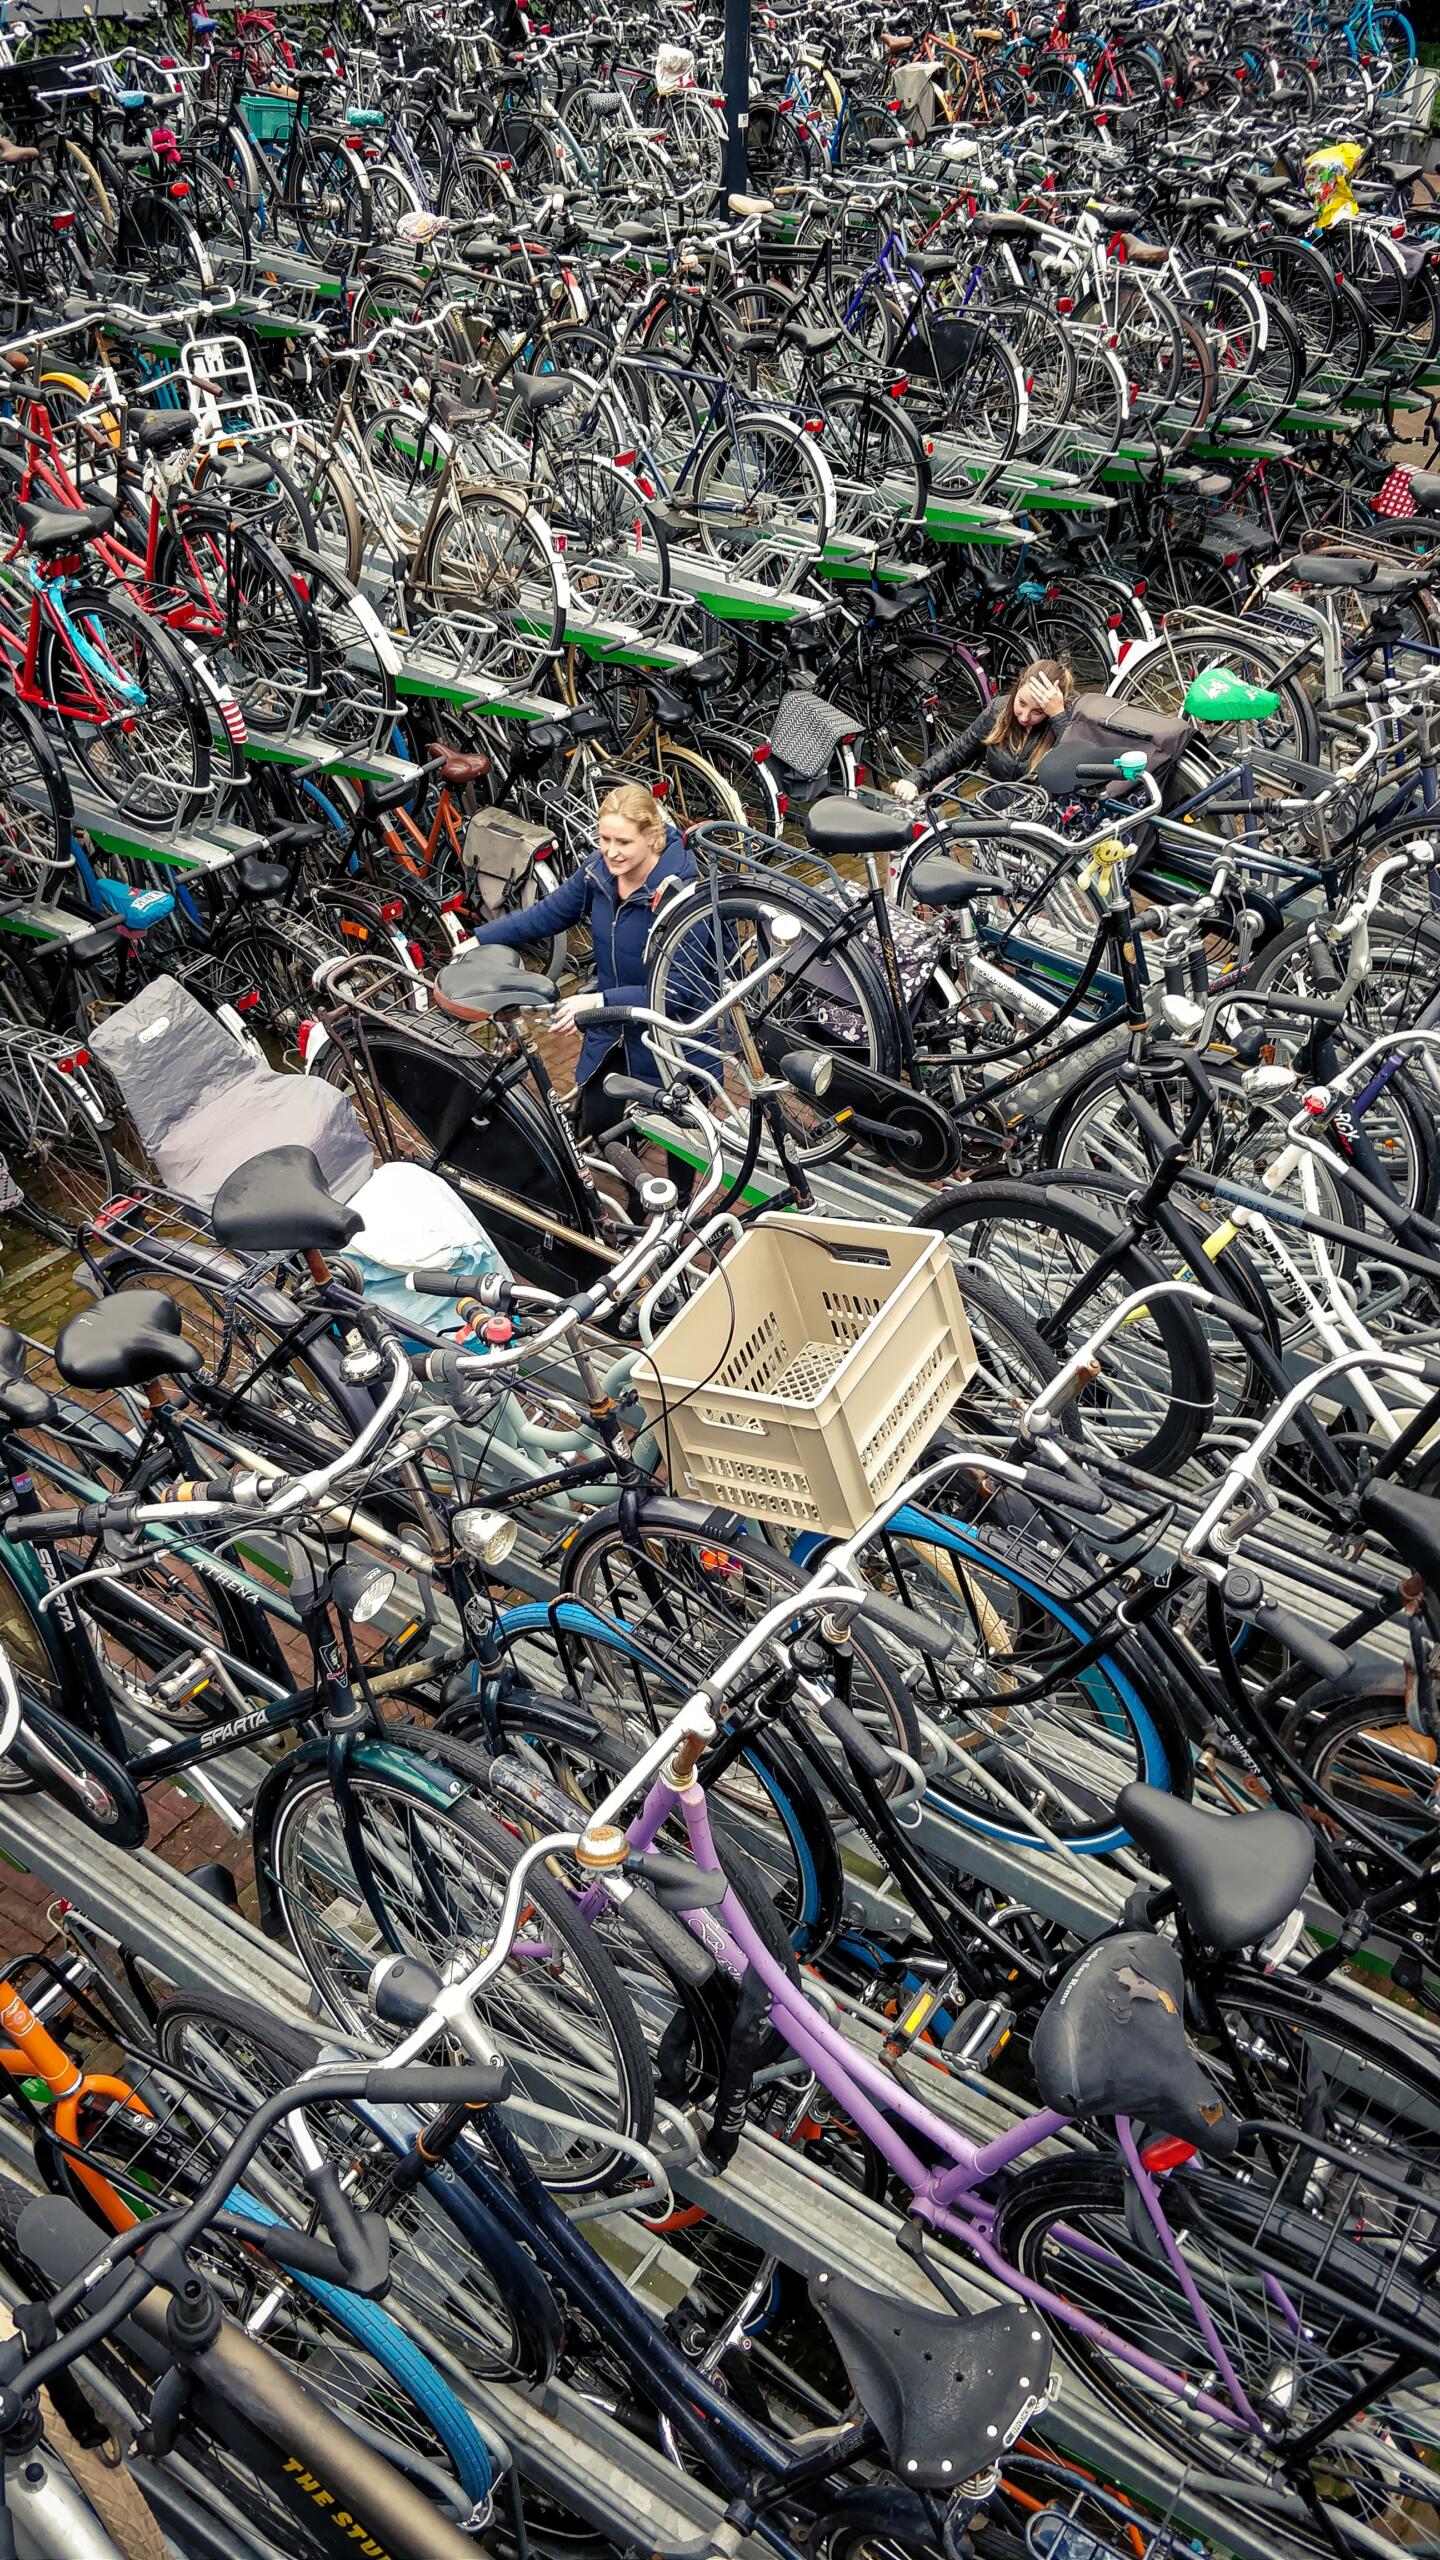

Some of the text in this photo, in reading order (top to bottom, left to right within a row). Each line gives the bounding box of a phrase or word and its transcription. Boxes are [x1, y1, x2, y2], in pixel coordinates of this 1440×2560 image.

[1006, 1048, 1063, 1084] Ranger
[556, 1103, 587, 1168] GAZELLE
[1218, 1190, 1300, 1227] VELORETTI
[508, 1479, 561, 1502] UNION
[35, 1548, 76, 1632] SPARTA
[192, 1561, 260, 1604] ATHENA
[200, 1709, 269, 1749] SPARTA
[1061, 1978, 1079, 2004] Remo
[282, 2457, 392, 2560] THE STU
